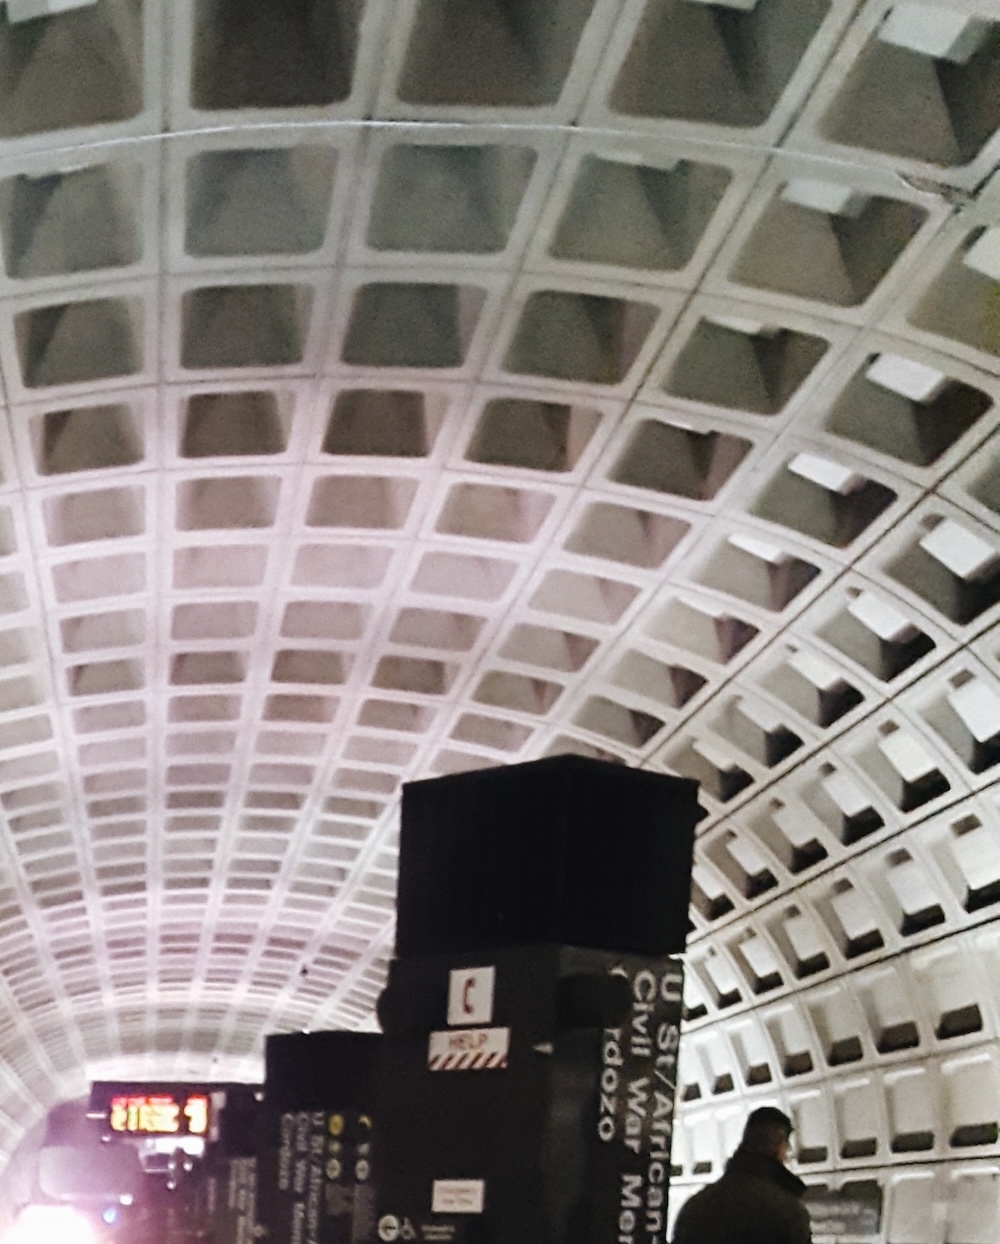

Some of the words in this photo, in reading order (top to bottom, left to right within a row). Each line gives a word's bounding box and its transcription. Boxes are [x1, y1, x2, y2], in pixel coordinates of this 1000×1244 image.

[633, 969, 657, 1058] Civil
[660, 972, 683, 1002] U
[448, 1032, 489, 1051] HELP
[598, 964, 628, 1142] rdozo
[625, 1077, 651, 1154] War
